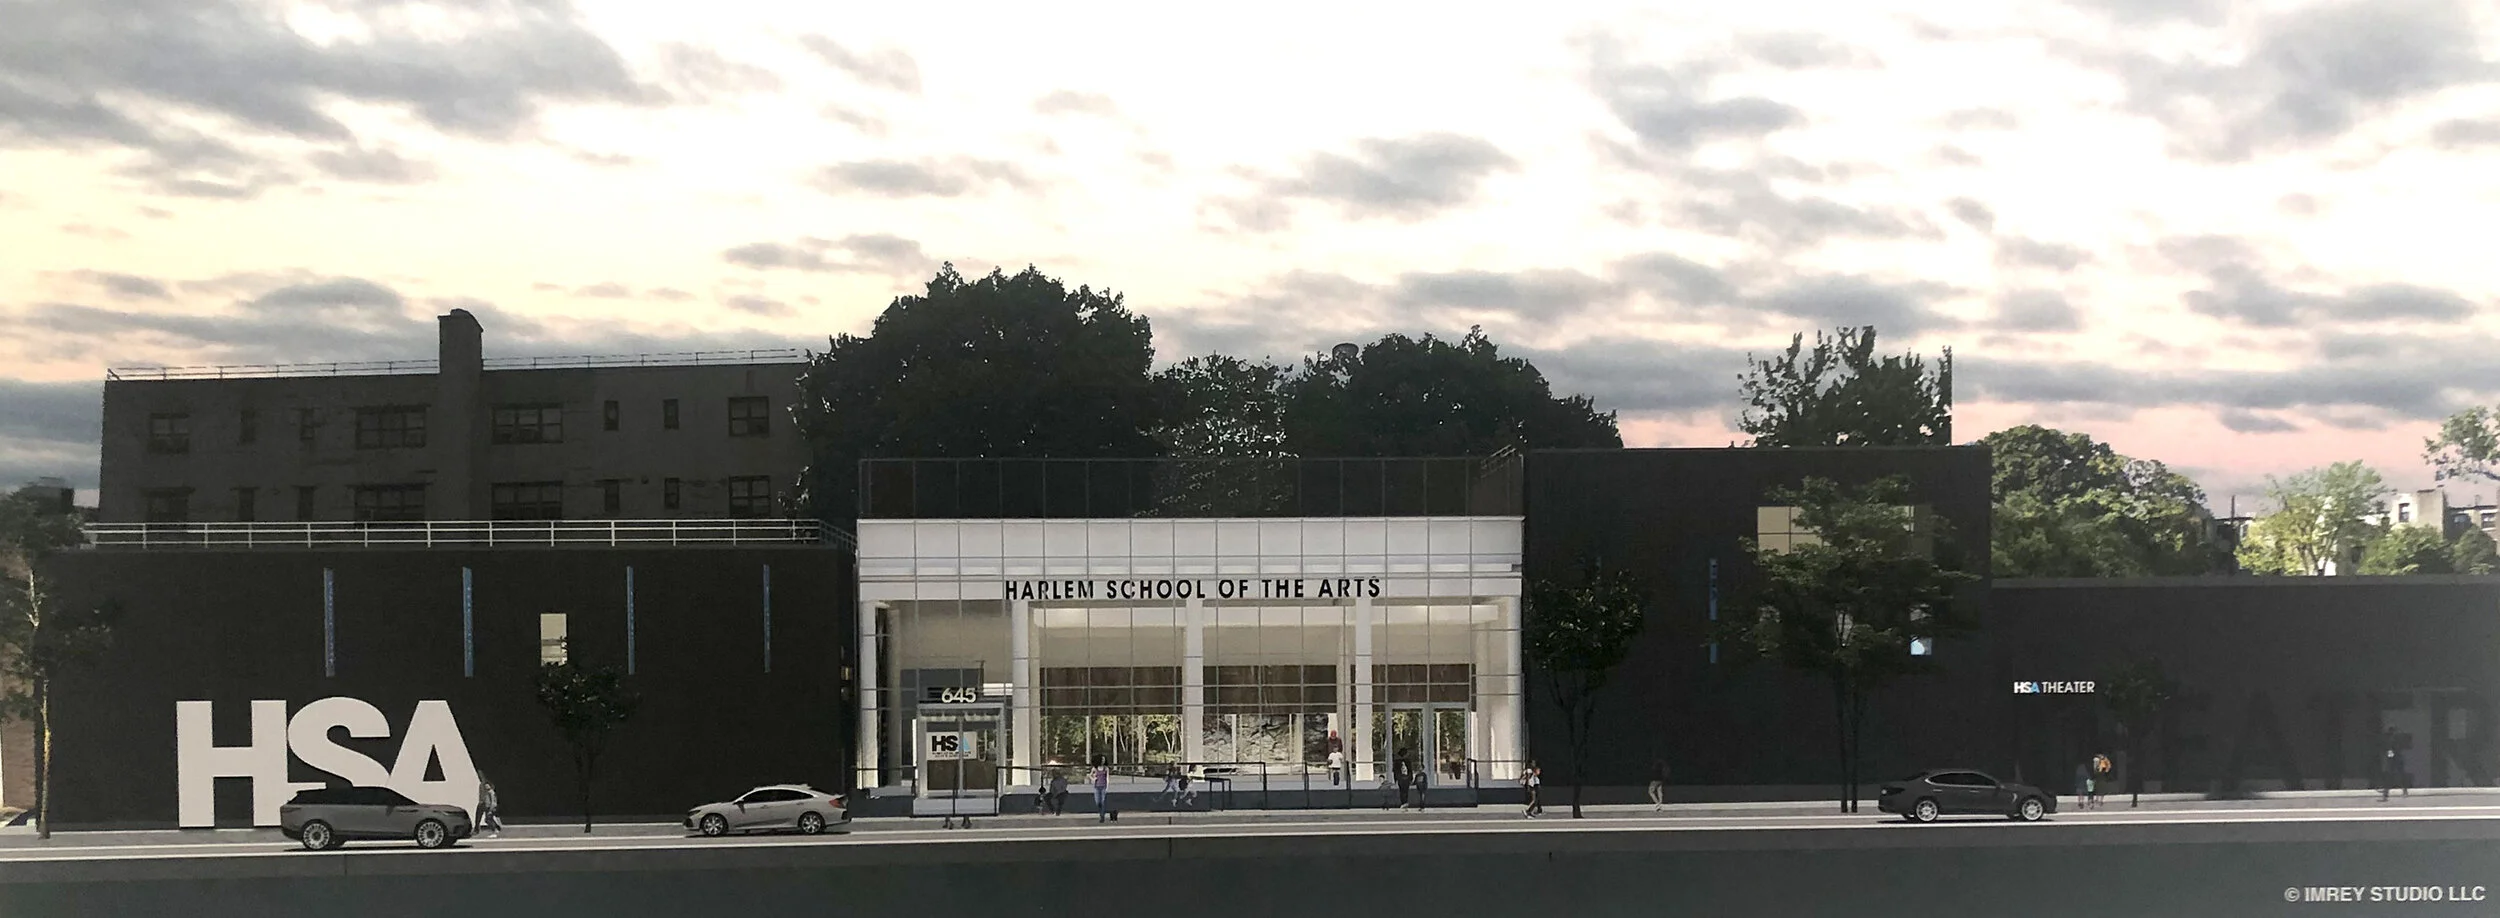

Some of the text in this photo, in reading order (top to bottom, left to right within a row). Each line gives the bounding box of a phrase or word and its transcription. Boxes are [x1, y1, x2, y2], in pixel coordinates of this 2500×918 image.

[1005, 578, 1380, 600] HARLEM SCHOOL OF THE ARTS
[941, 687, 977, 703] 645
[2013, 681, 2096, 693] HSA THEATER
[931, 735, 971, 752] HSA
[176, 696, 488, 828] HSA
